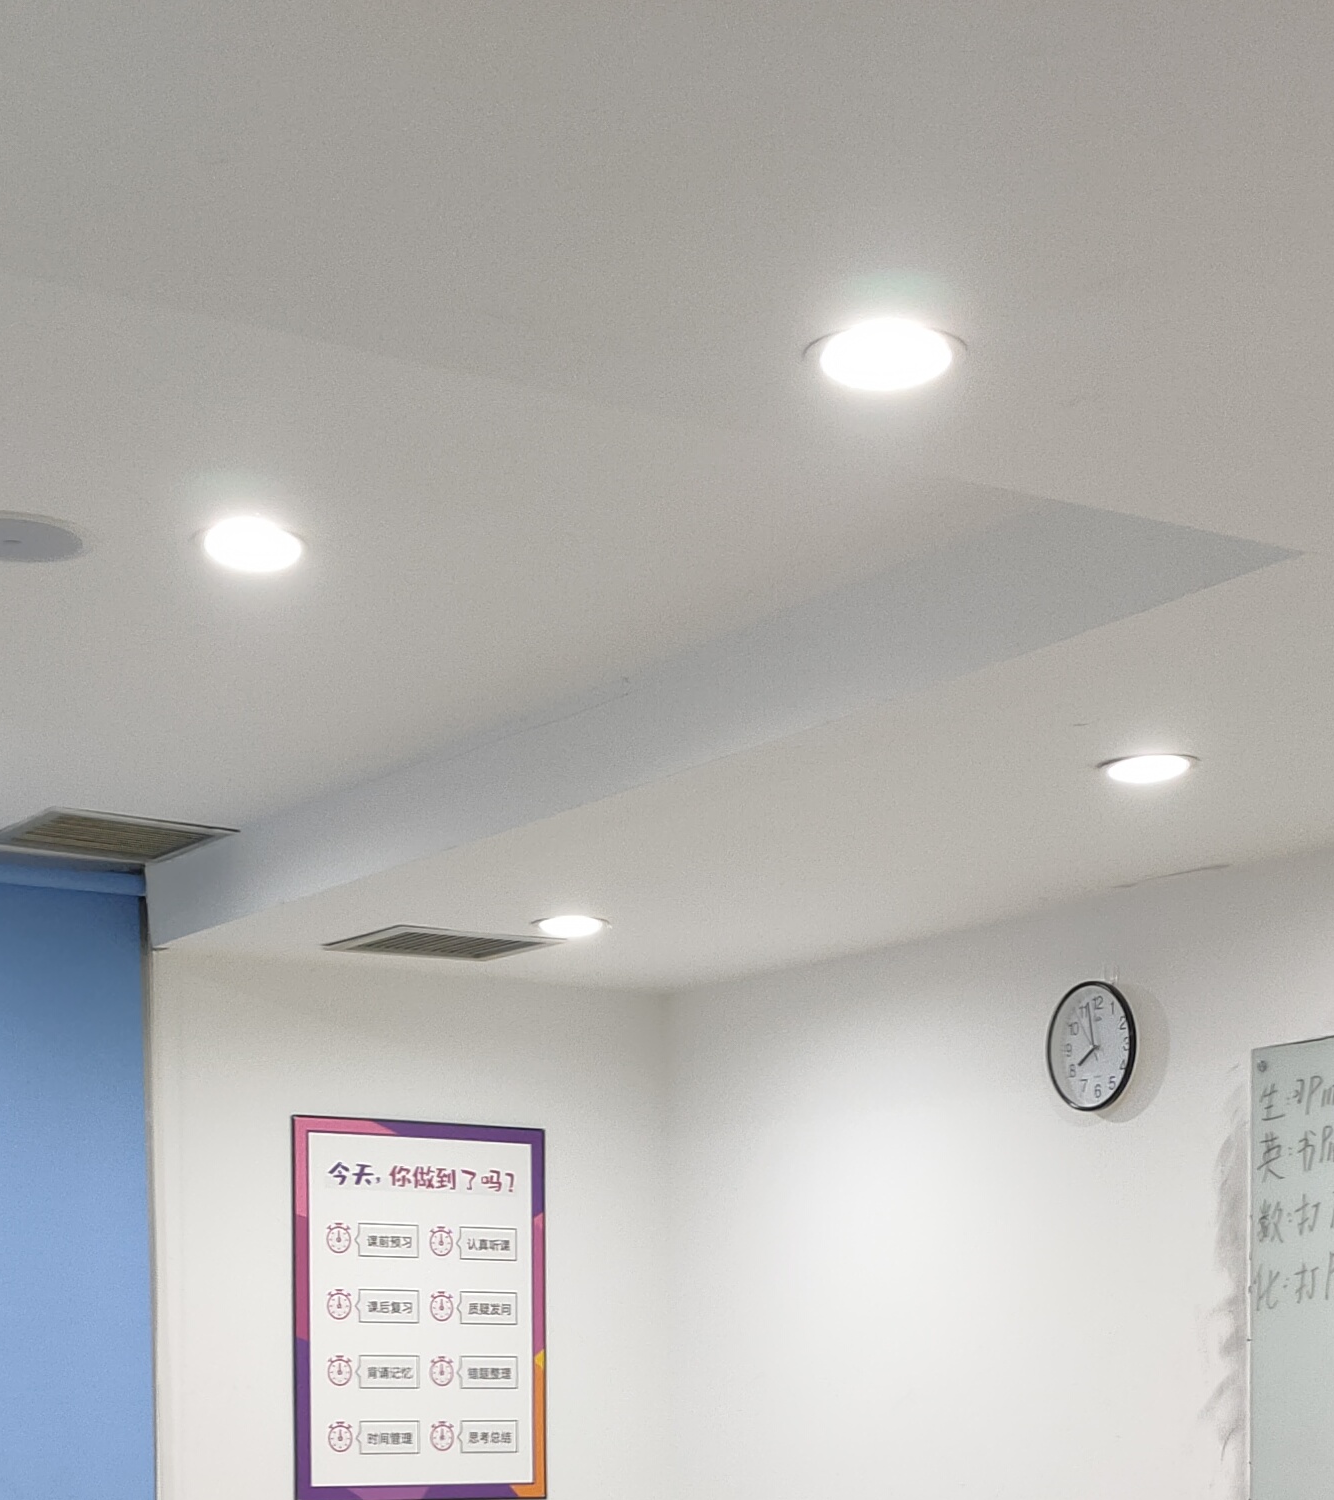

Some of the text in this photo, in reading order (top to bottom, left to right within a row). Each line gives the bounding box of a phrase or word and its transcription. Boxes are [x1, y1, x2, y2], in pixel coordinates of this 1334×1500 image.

[1092, 995, 1104, 1010] 12
[1068, 1021, 1080, 1036] 10
[1119, 1016, 1127, 1031] 2
[1123, 1036, 1130, 1051] 3
[1068, 1064, 1077, 1078] 8
[1079, 1078, 1089, 1093] 7
[1108, 1076, 1116, 1090] 5
[1094, 1084, 1102, 1098] 6
[328, 1161, 516, 1193] 今天，你做到了吗？
[367, 1235, 413, 1249] 课前预习
[467, 1238, 511, 1252] 认真听课
